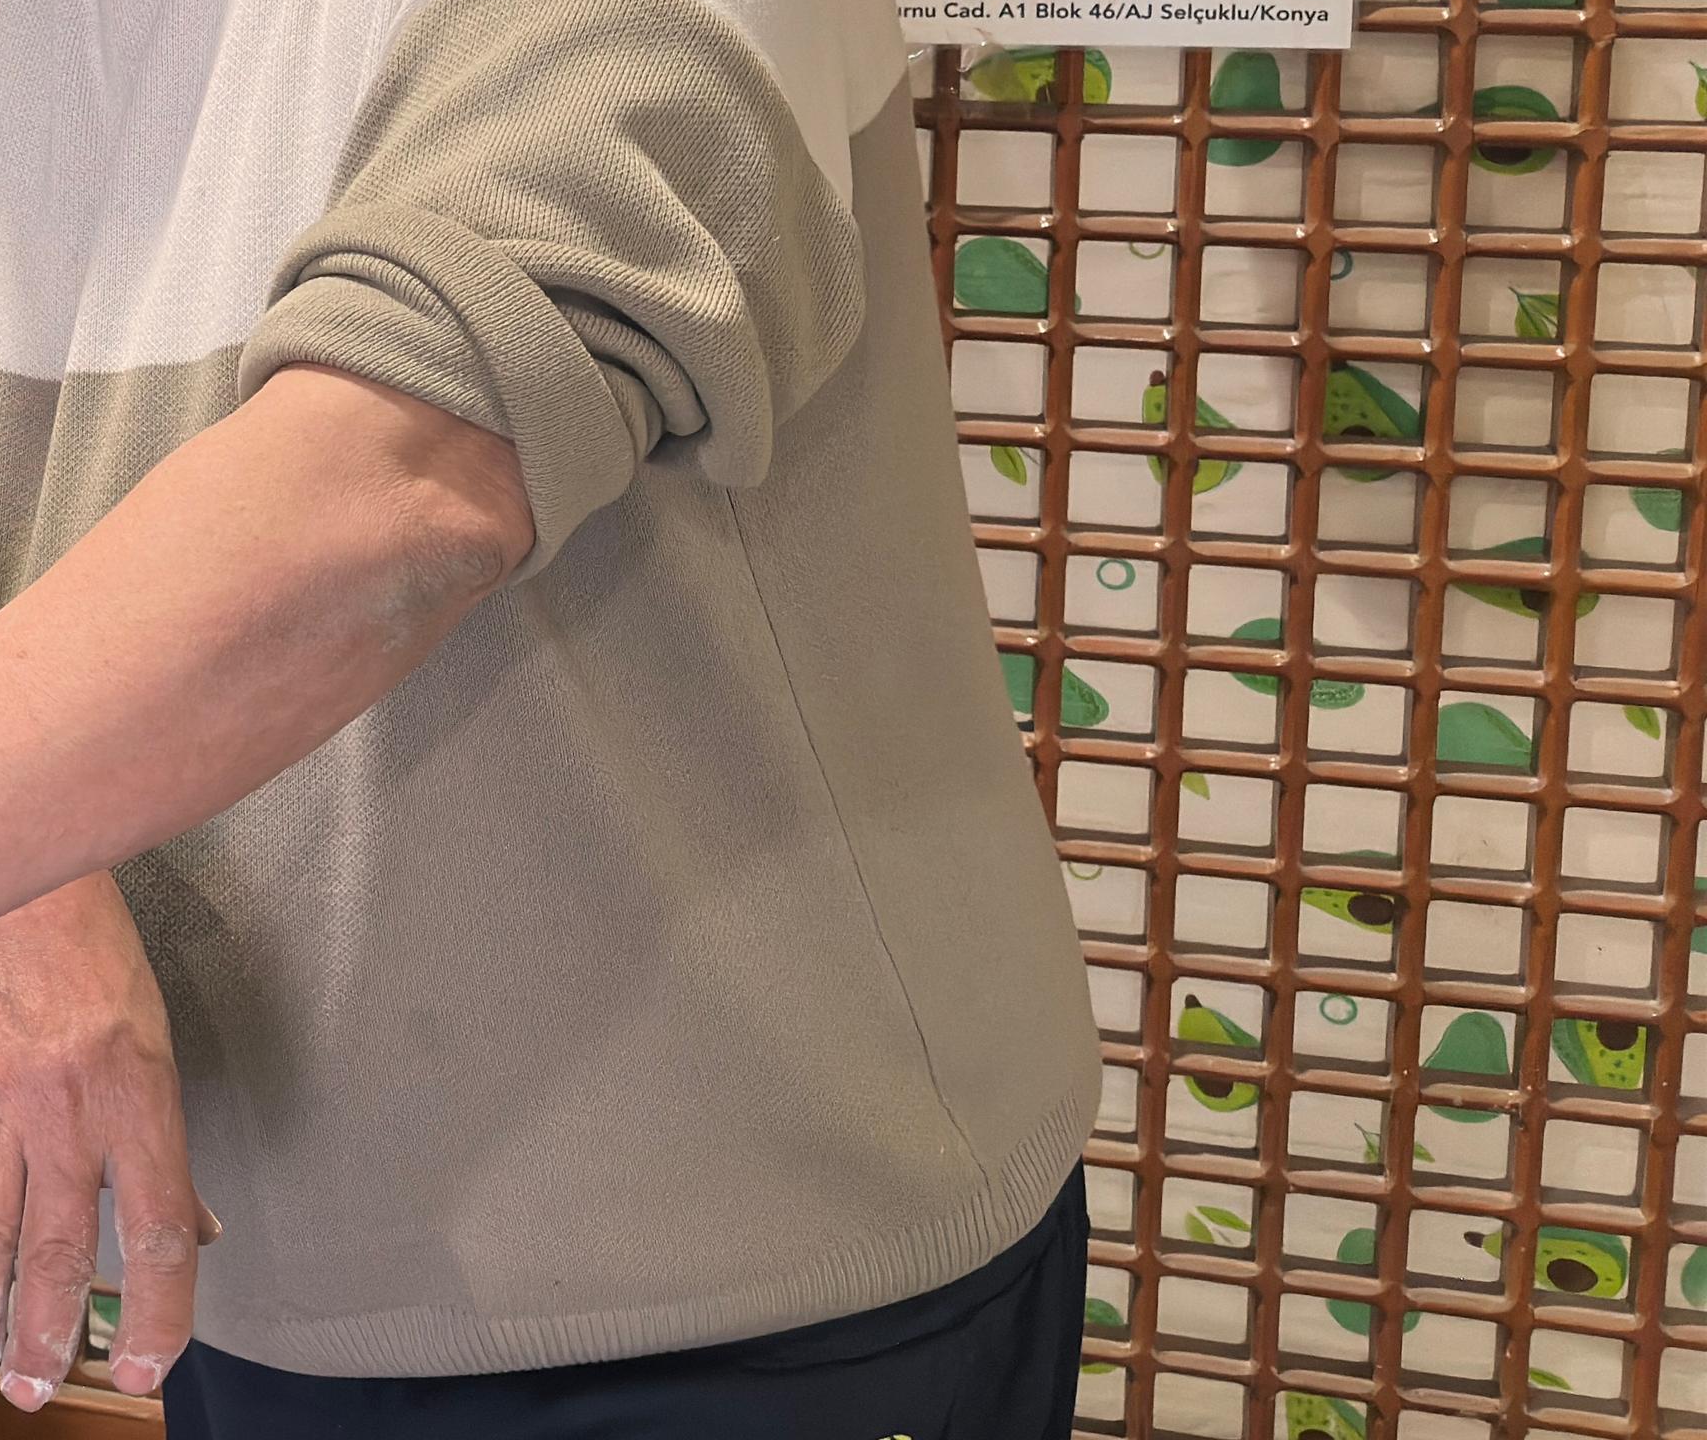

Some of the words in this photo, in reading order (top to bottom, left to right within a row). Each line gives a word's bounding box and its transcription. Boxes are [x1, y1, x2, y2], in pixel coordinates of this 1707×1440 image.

[898, 5, 937, 19] rnu
[944, 1, 991, 19] Cad.
[998, 2, 1026, 20] A1
[1035, 2, 1082, 20] Blok
[1088, 3, 1154, 21] 46/AJ
[1160, 3, 1329, 26] Selçuklu/Konya
